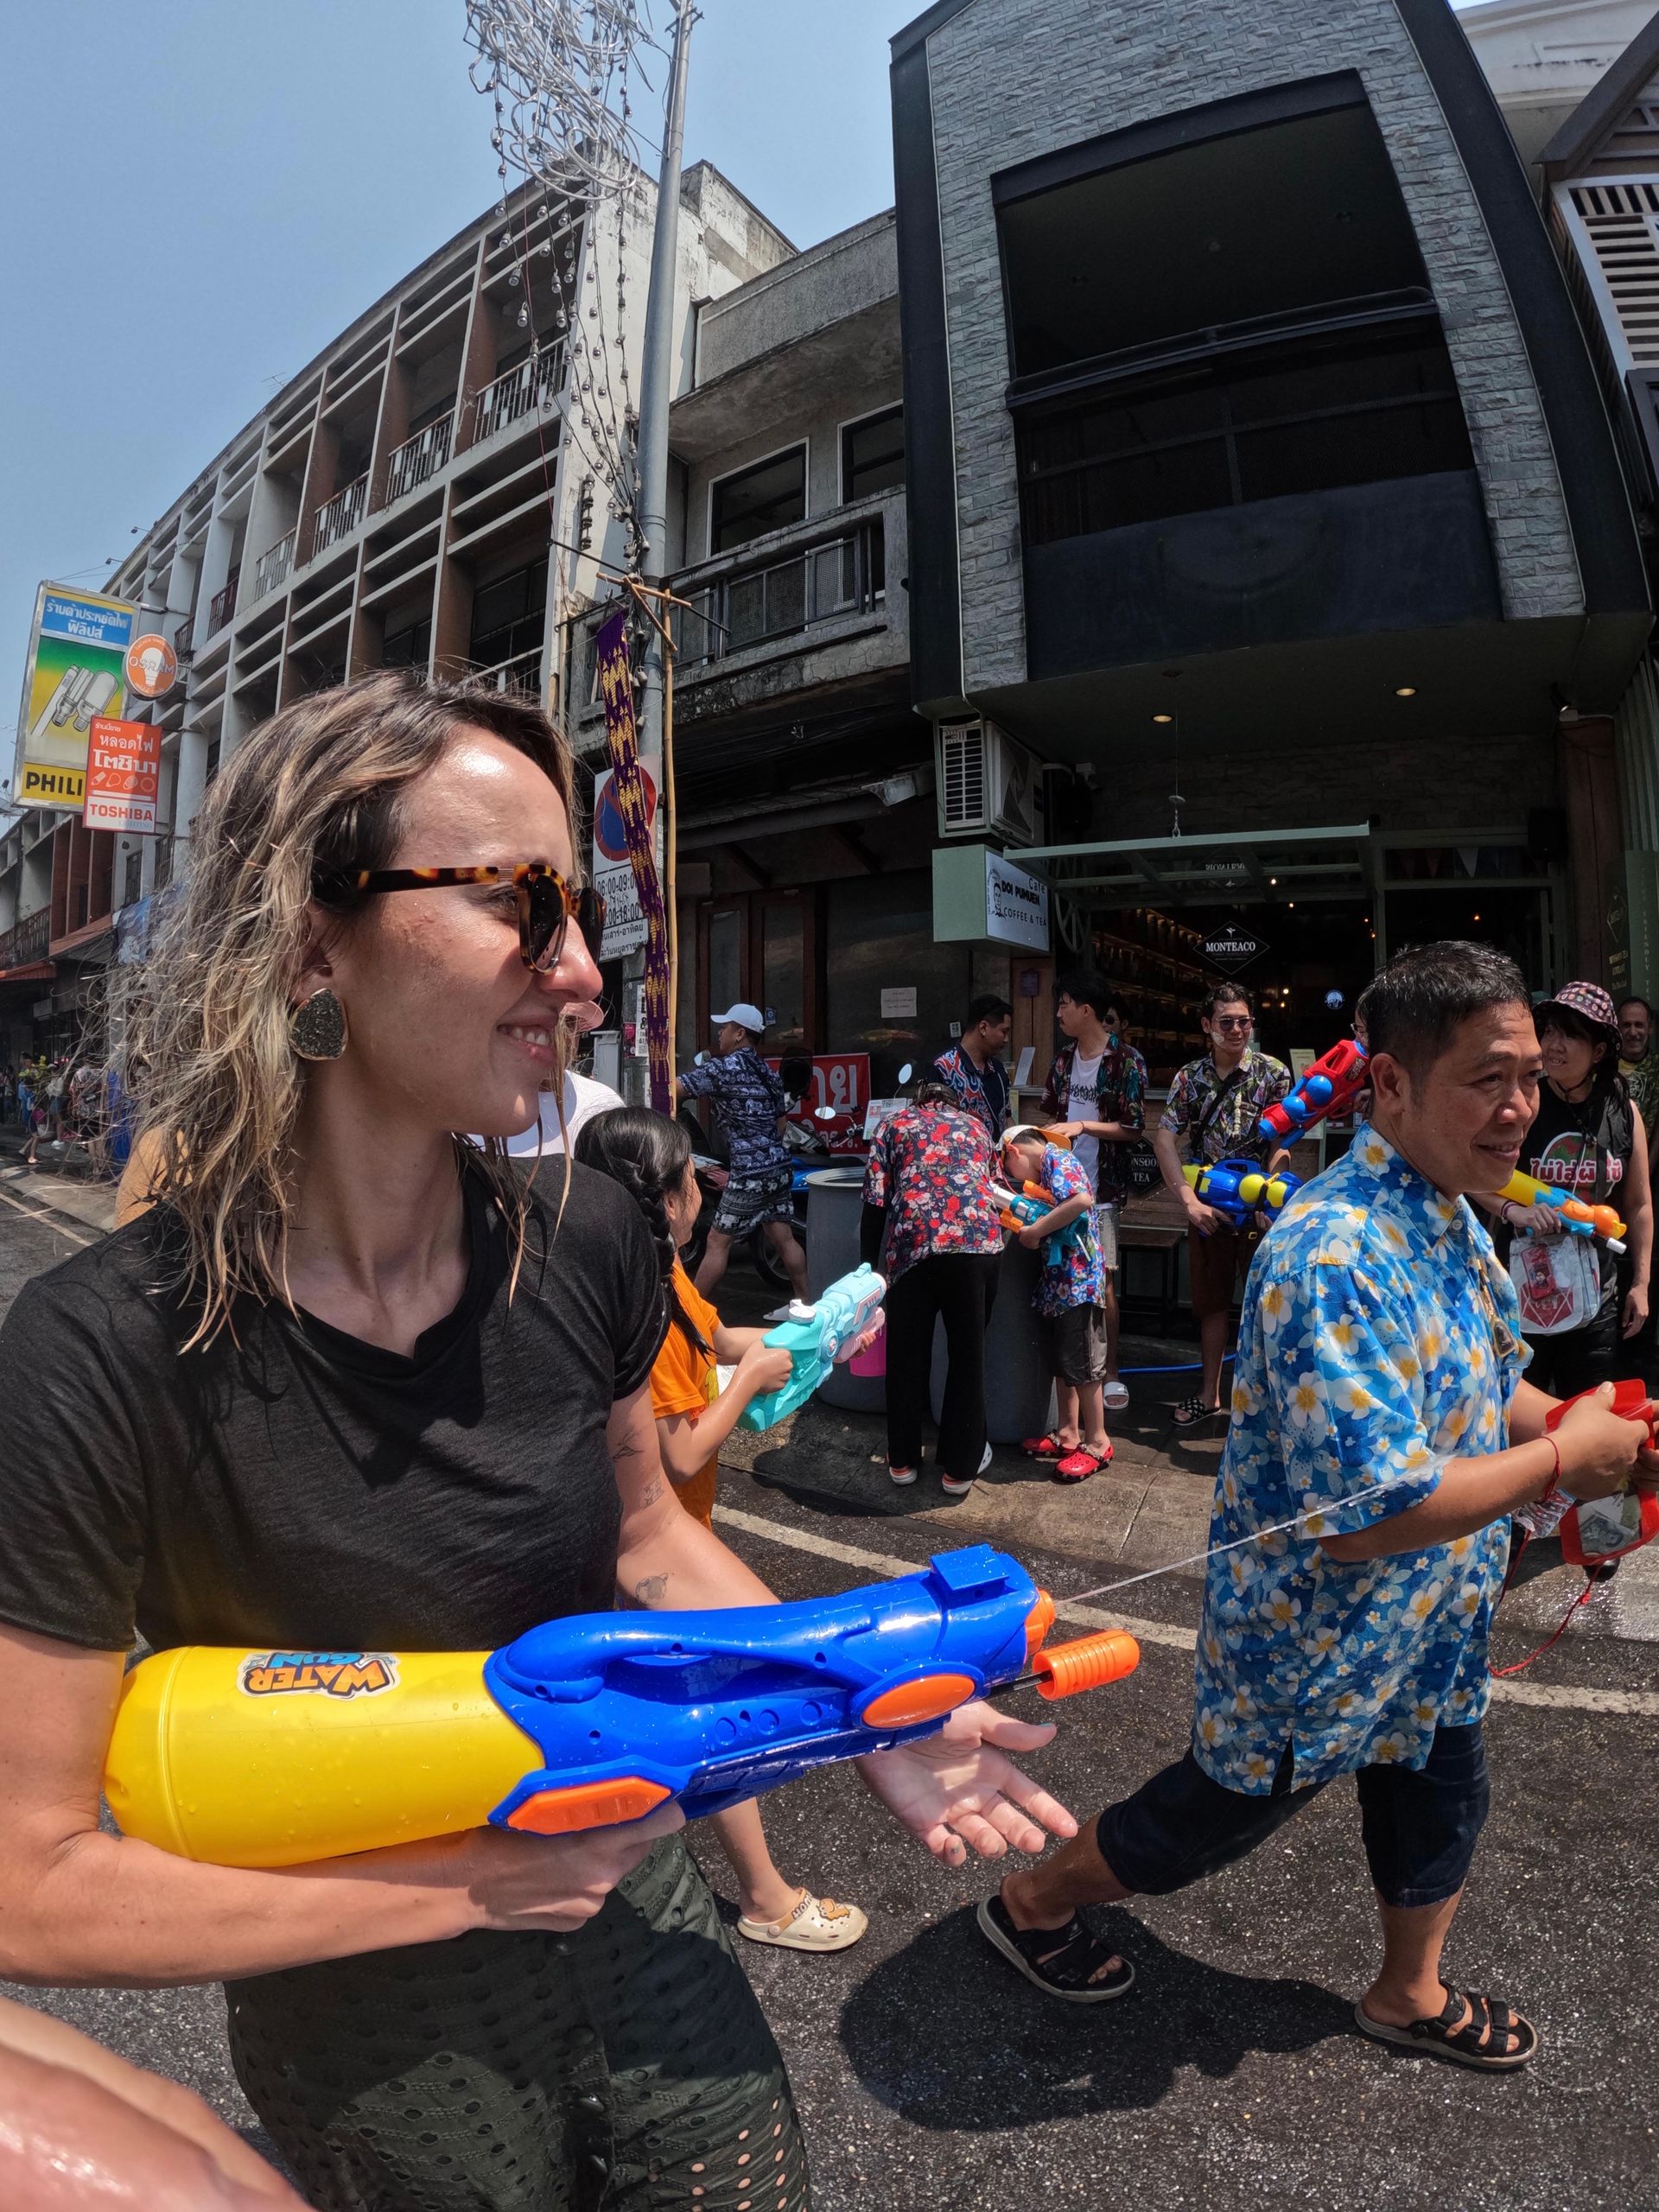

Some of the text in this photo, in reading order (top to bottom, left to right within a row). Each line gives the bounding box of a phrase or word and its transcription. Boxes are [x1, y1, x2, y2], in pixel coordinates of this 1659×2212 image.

[67, 620, 105, 639] ฟิลิปส์
[130, 656, 175, 675] OSRAM
[99, 734, 154, 753] หลอดไฟ
[92, 748, 156, 774] โตชิบา
[25, 772, 84, 797] PHILI
[90, 804, 153, 821] TOSHIBA
[1001, 880, 1014, 895] DOI
[1003, 907, 1046, 926] COFFEE & TEA
[1205, 942, 1256, 951] MONTEACO
[787, 1065, 857, 1114] าย
[1132, 1173, 1150, 1182] TEA
[1530, 1157, 1623, 1183] ไม่ใส่ผัชี
[270, 1651, 362, 1668] GUN
[247, 1660, 387, 1694] WATER
